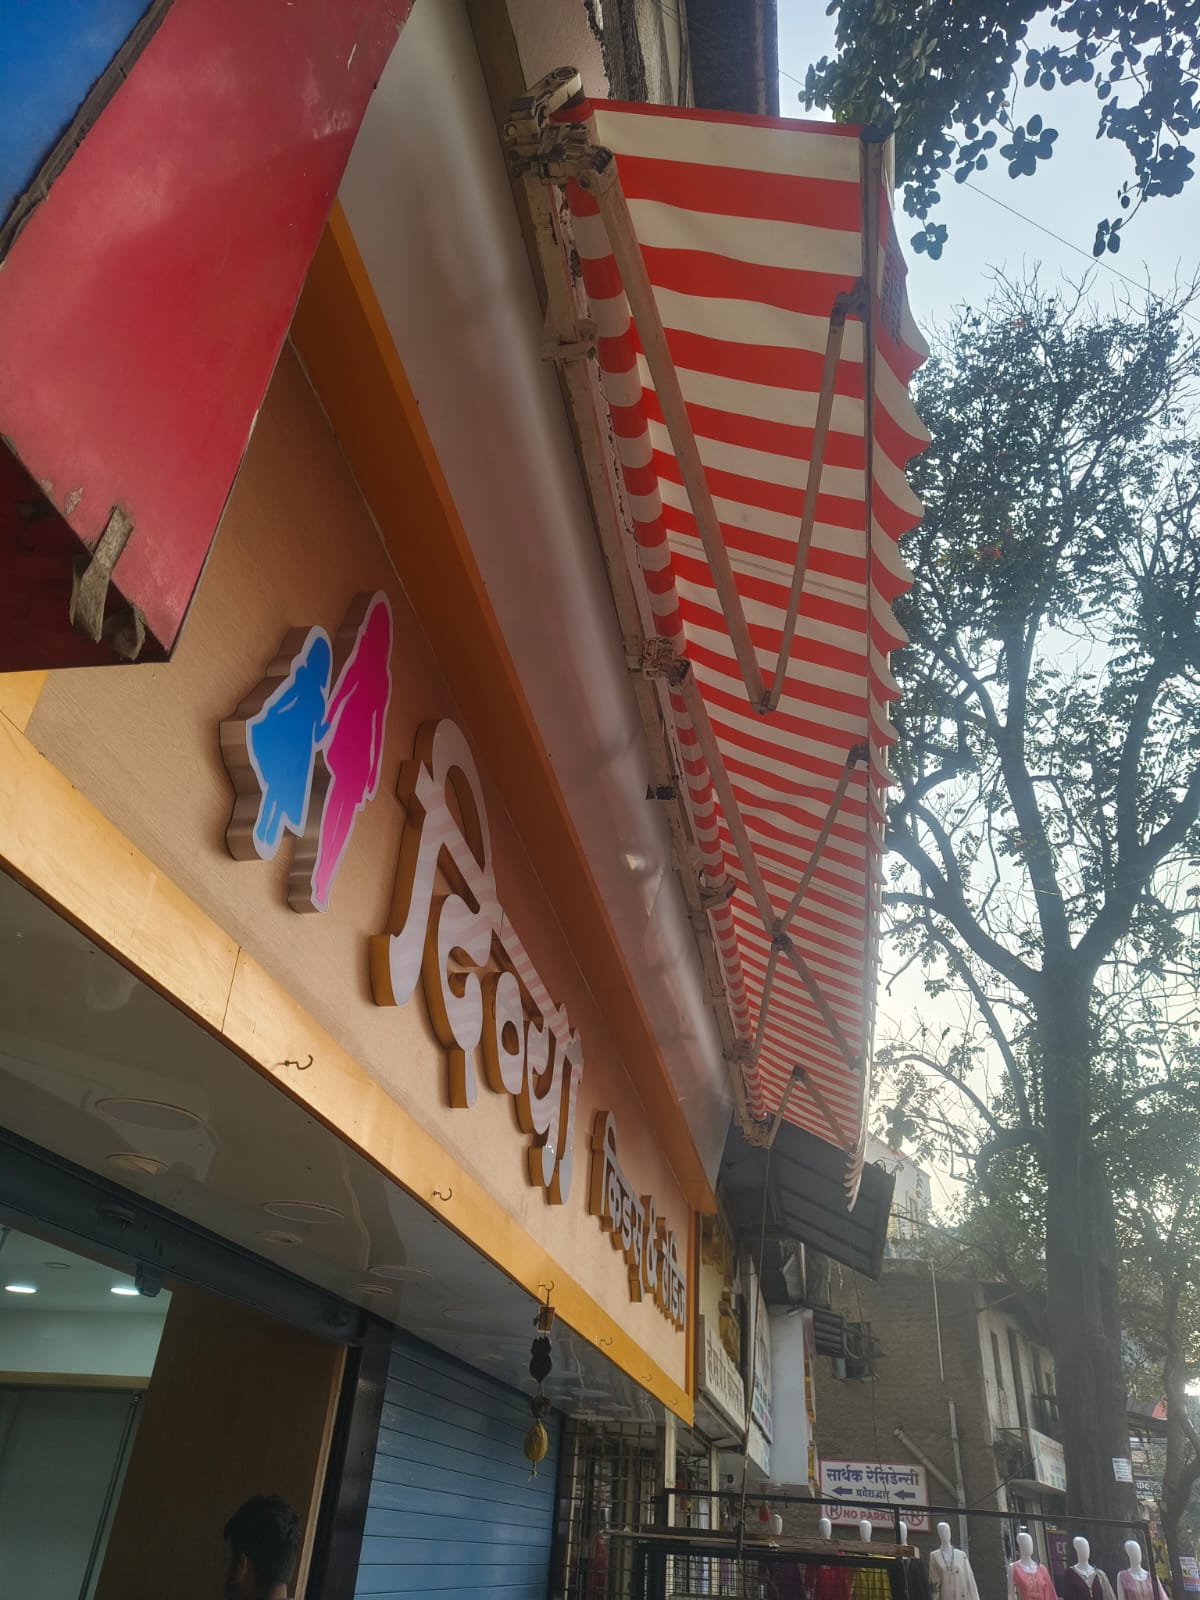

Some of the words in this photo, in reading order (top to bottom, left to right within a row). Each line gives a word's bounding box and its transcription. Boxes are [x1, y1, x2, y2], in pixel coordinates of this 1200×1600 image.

[378, 718, 583, 1206] दिव्या
[643, 1195, 658, 1290] &
[826, 1464, 863, 1482] सार्थक
[843, 1509, 858, 1519] NO
[860, 1510, 904, 1521] PARKIN
